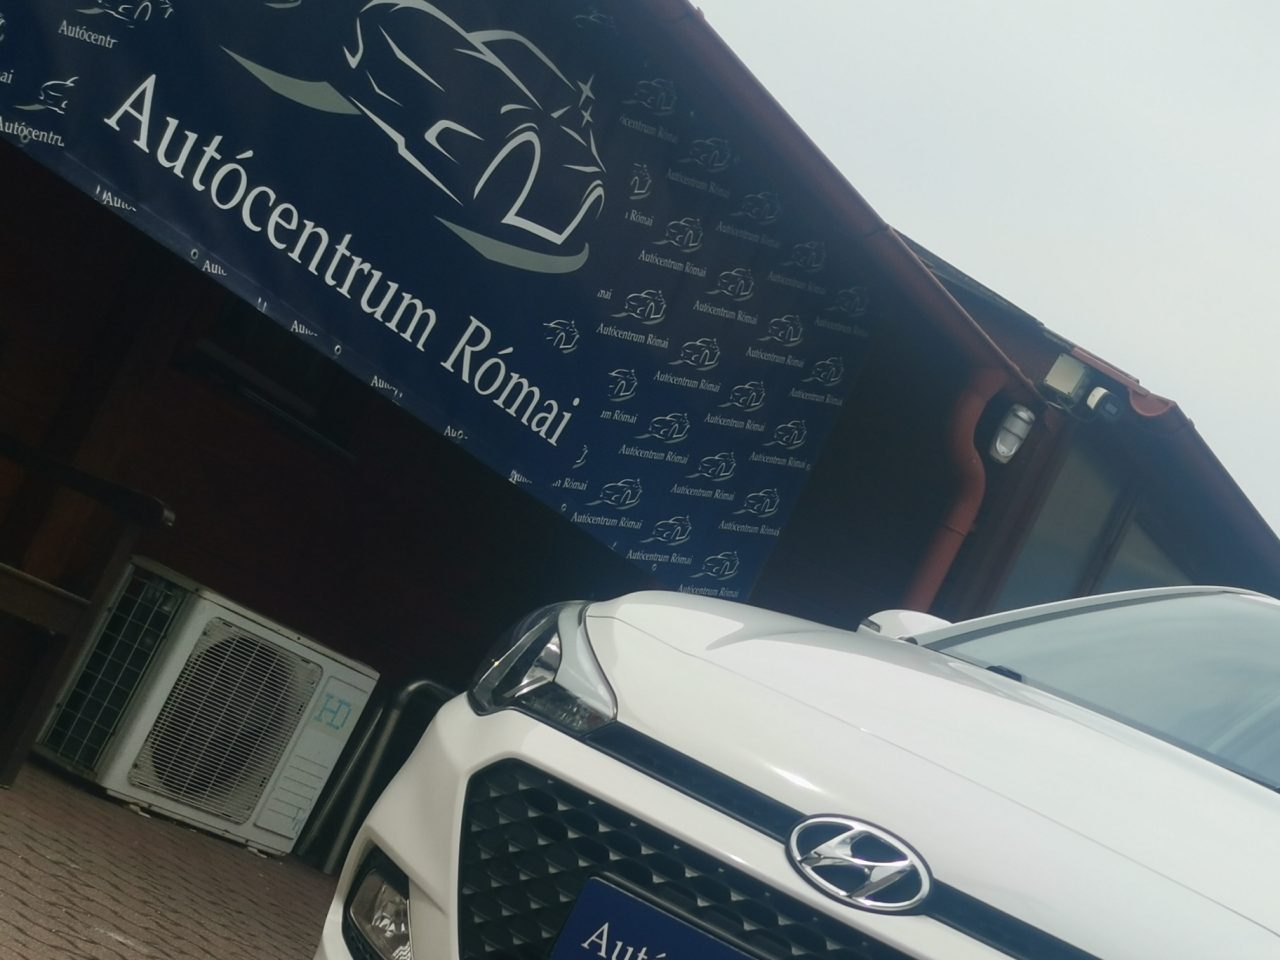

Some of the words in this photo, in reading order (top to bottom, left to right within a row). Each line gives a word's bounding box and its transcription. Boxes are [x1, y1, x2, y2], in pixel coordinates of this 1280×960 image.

[104, 73, 437, 352] Autócentrum
[440, 315, 581, 447] Római
[638, 250, 684, 272] Autócentrum
[595, 323, 645, 344] Autócentrum
[653, 370, 698, 388] Autócentrum
[618, 444, 665, 460] Autócentrum
[570, 512, 618, 526] Autócentrum
